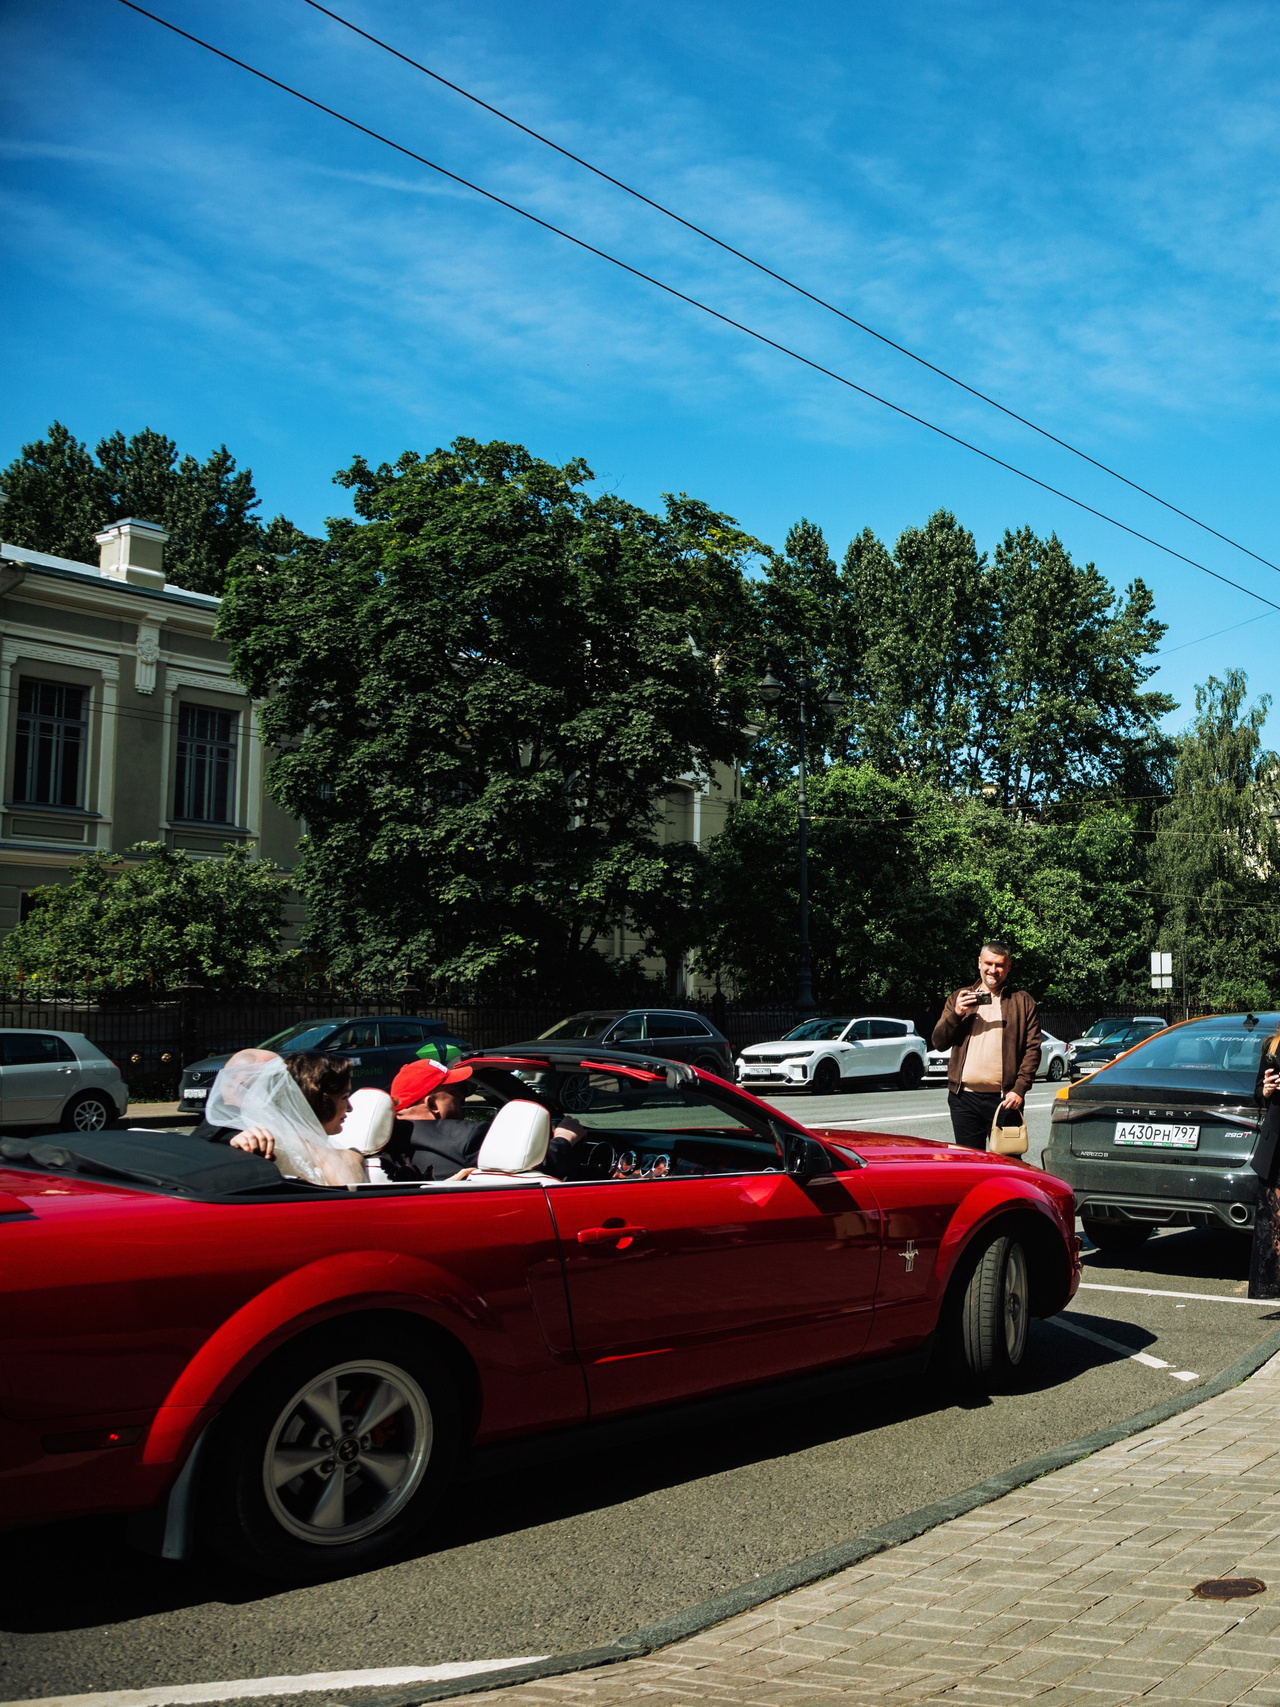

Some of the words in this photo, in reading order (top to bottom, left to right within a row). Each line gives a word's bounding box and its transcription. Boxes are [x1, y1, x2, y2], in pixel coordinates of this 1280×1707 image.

[1116, 1108, 1192, 1117] CHERY
[1119, 1124, 1171, 1141] А430РН
[1174, 1126, 1196, 1139] 797
